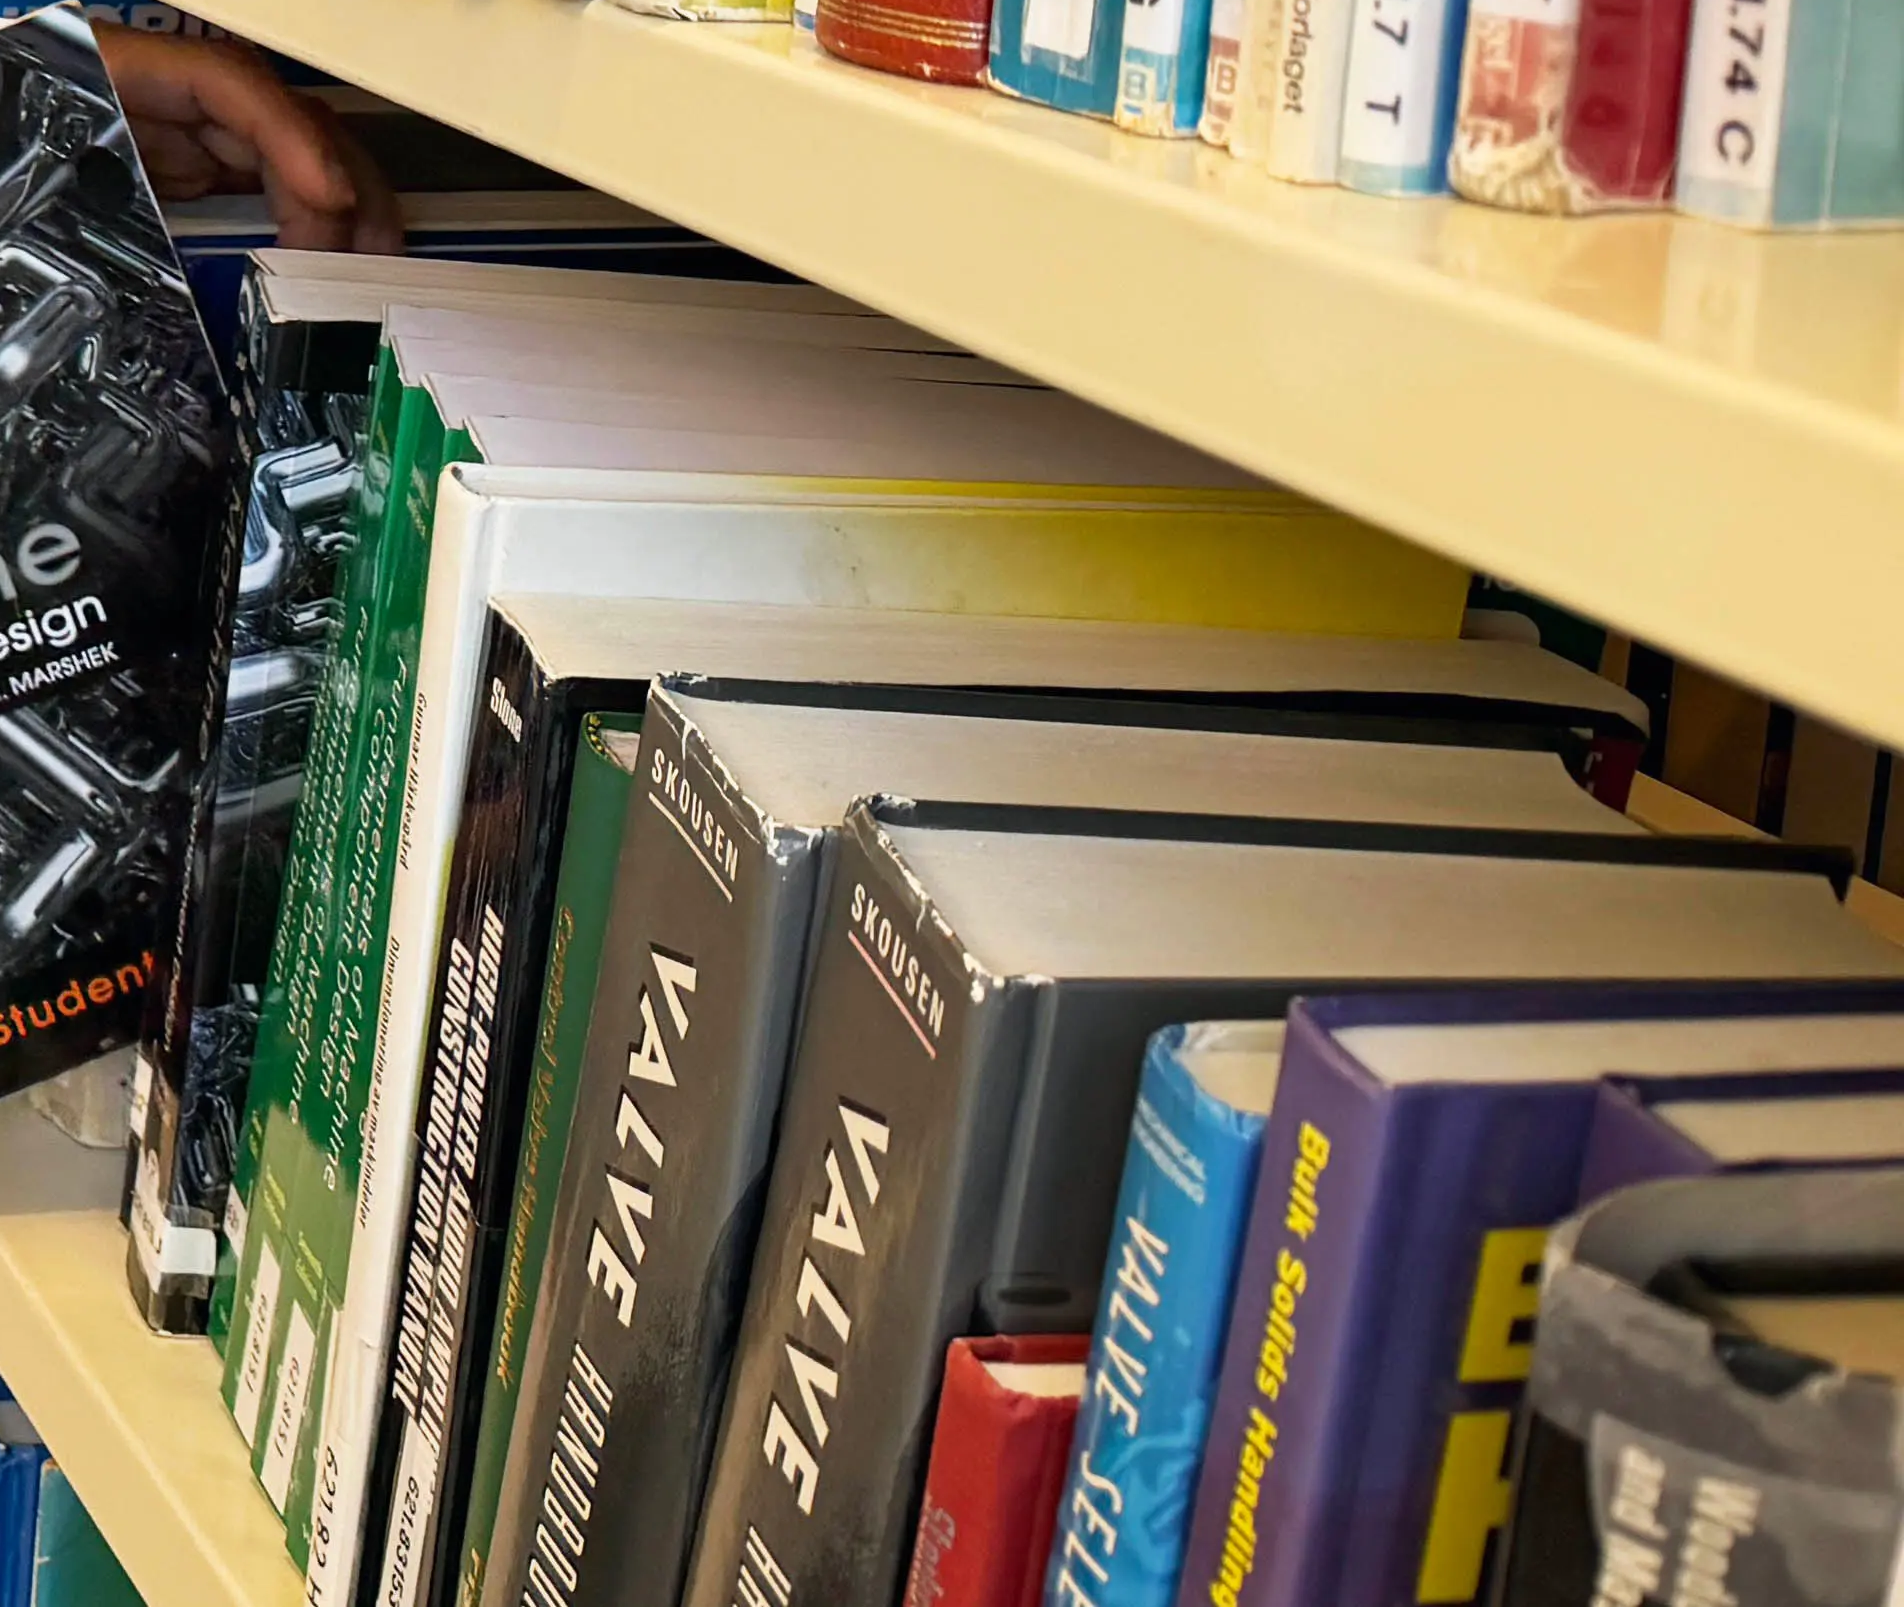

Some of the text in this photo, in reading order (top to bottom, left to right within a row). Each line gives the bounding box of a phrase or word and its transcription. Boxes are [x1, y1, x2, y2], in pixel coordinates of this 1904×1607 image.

[1364, 94, 1403, 125] T
[1712, 120, 1757, 166] C
[8, 639, 120, 699] MARSHEK
[412, 692, 428, 764] Gunnar
[490, 678, 526, 743] Slone
[318, 708, 387, 1099] Component Design
[648, 748, 740, 884] SKOUSEN
[286, 903, 318, 1035] Design
[321, 654, 408, 1194] Fundamentals of Machine
[540, 905, 577, 1053] Control
[848, 881, 947, 1041] SKOUSEN
[287, 950, 324, 1126] Machine
[371, 935, 401, 1111] Dimensionering av
[434, 905, 505, 1311] HIGH-POWER AUDIO
[393, 937, 474, 1415] CONSTRUCTION MANUAL
[587, 950, 698, 1330] VALVE
[496, 1182, 540, 1392] Handbook
[762, 1099, 892, 1515] VALVE
[1094, 1215, 1170, 1437] VALVE
[1210, 1121, 1331, 1607] Bulk Solids Handling
[311, 1444, 339, 1569] 621.82
